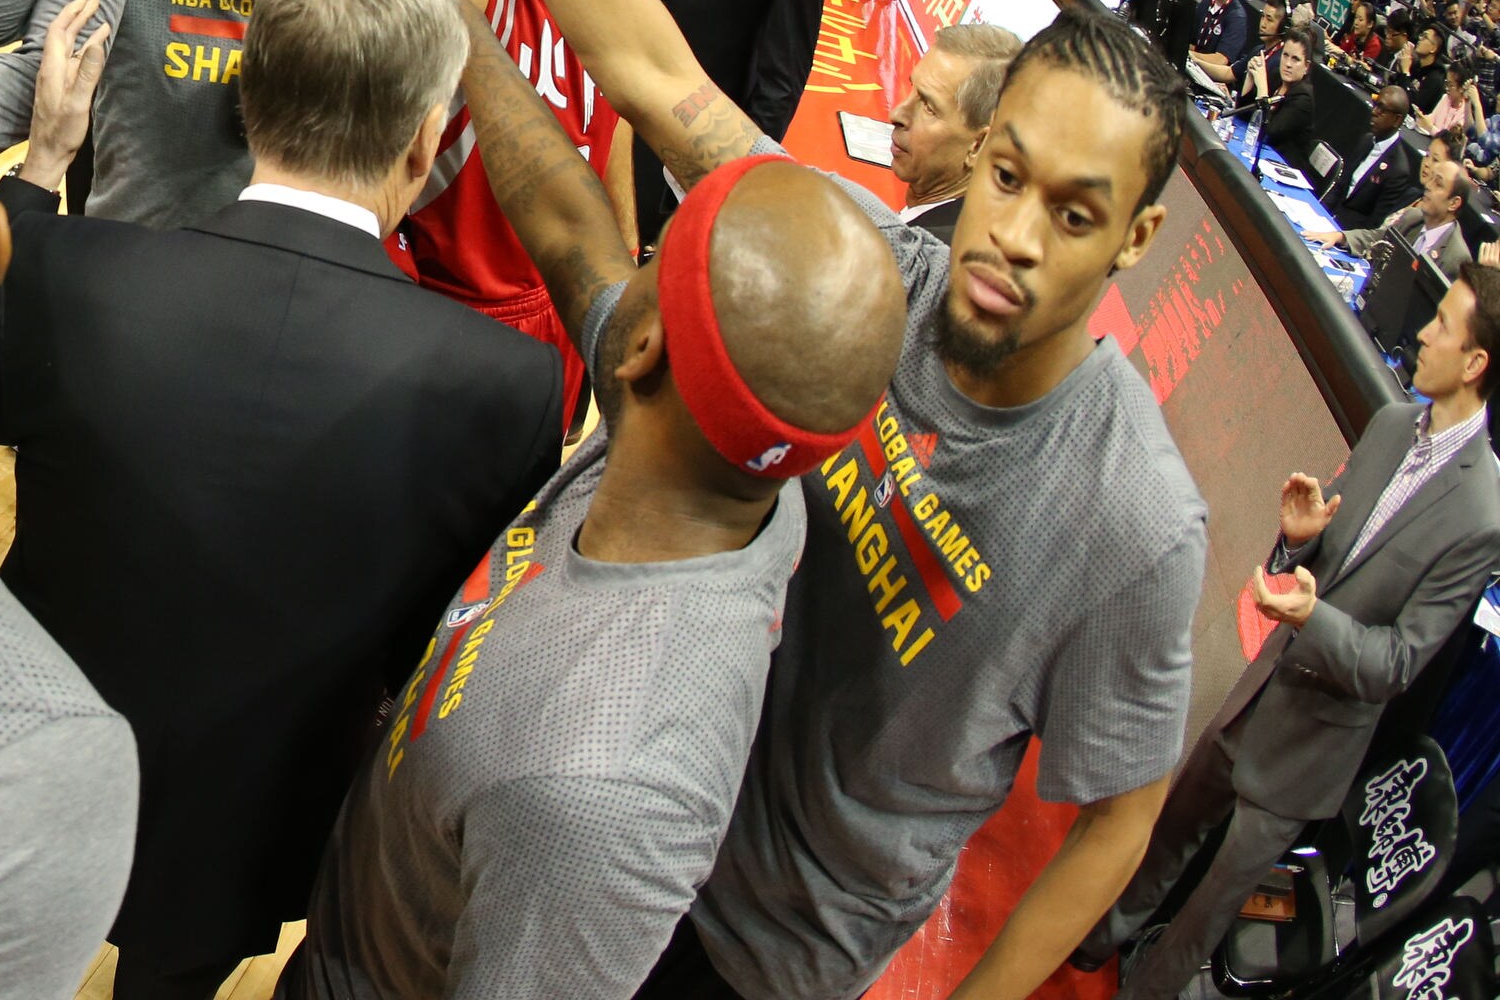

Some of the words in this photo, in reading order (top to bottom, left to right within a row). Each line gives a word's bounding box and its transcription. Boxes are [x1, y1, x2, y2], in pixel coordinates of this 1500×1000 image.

[164, 41, 243, 84] SHA
[820, 450, 936, 668] ANGHAI
[913, 492, 992, 593] GAMES
[438, 618, 495, 720] GAMES
